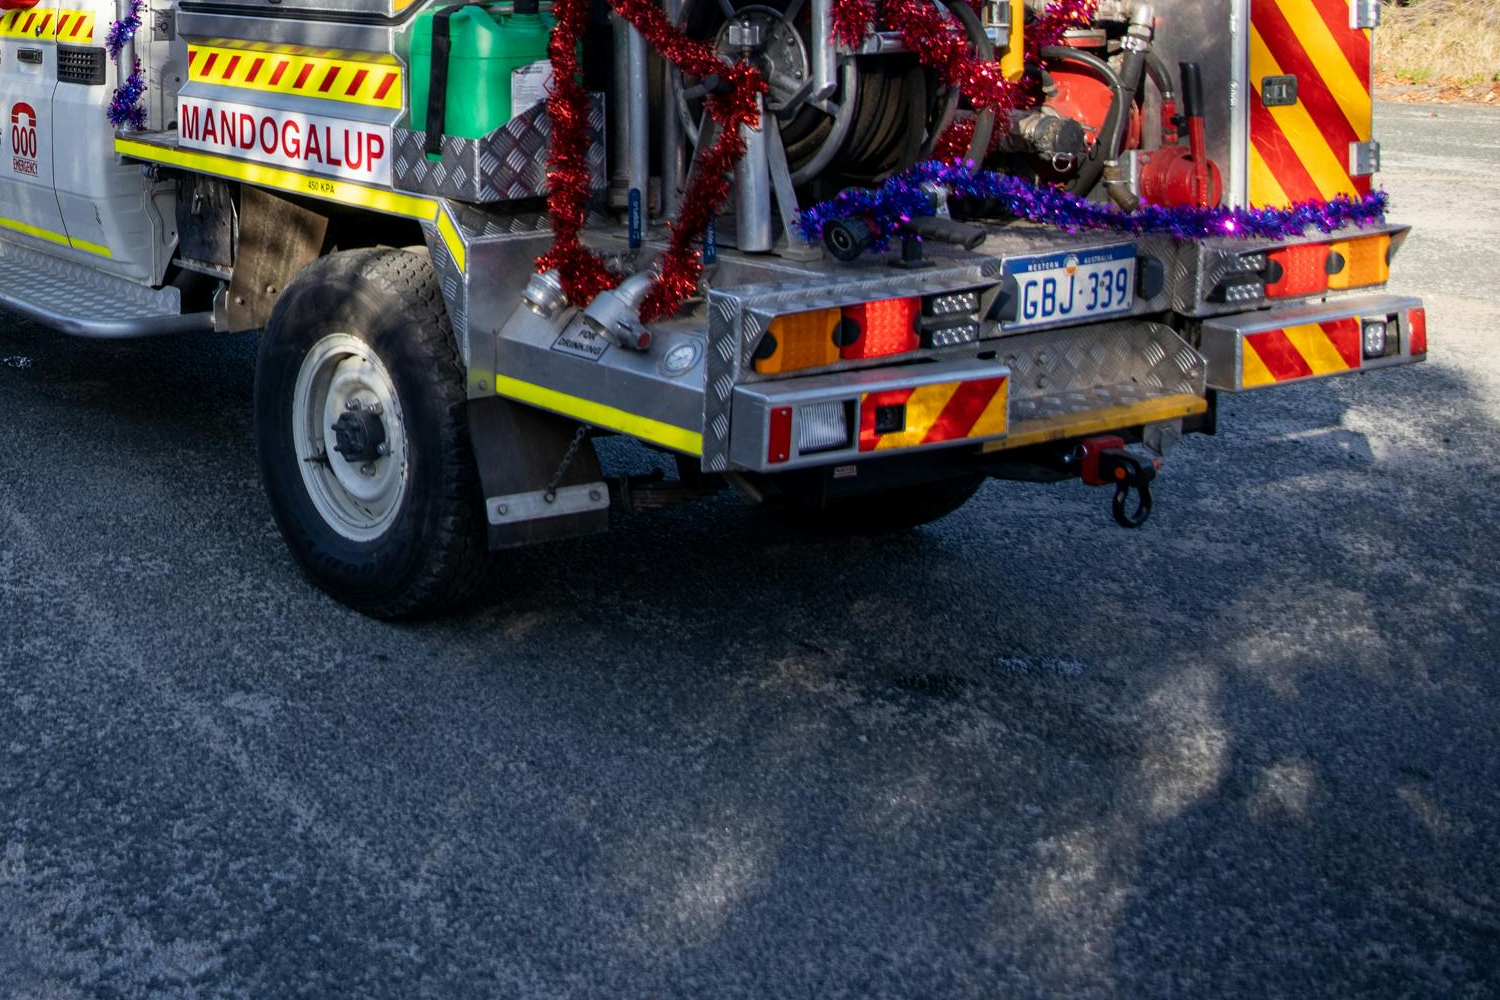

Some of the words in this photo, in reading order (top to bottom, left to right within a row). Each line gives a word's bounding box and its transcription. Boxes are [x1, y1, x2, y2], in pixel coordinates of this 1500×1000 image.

[11, 124, 37, 159] 000
[181, 103, 385, 173] MANDOGALUP
[12, 157, 39, 176] EMERGENCY
[307, 180, 319, 192] 450
[320, 183, 335, 194] KPA
[1027, 261, 1060, 272] WESTERN
[1083, 254, 1113, 265] AUSTRALIA
[578, 330, 597, 341] FOR
[557, 338, 602, 355] DRINKING
